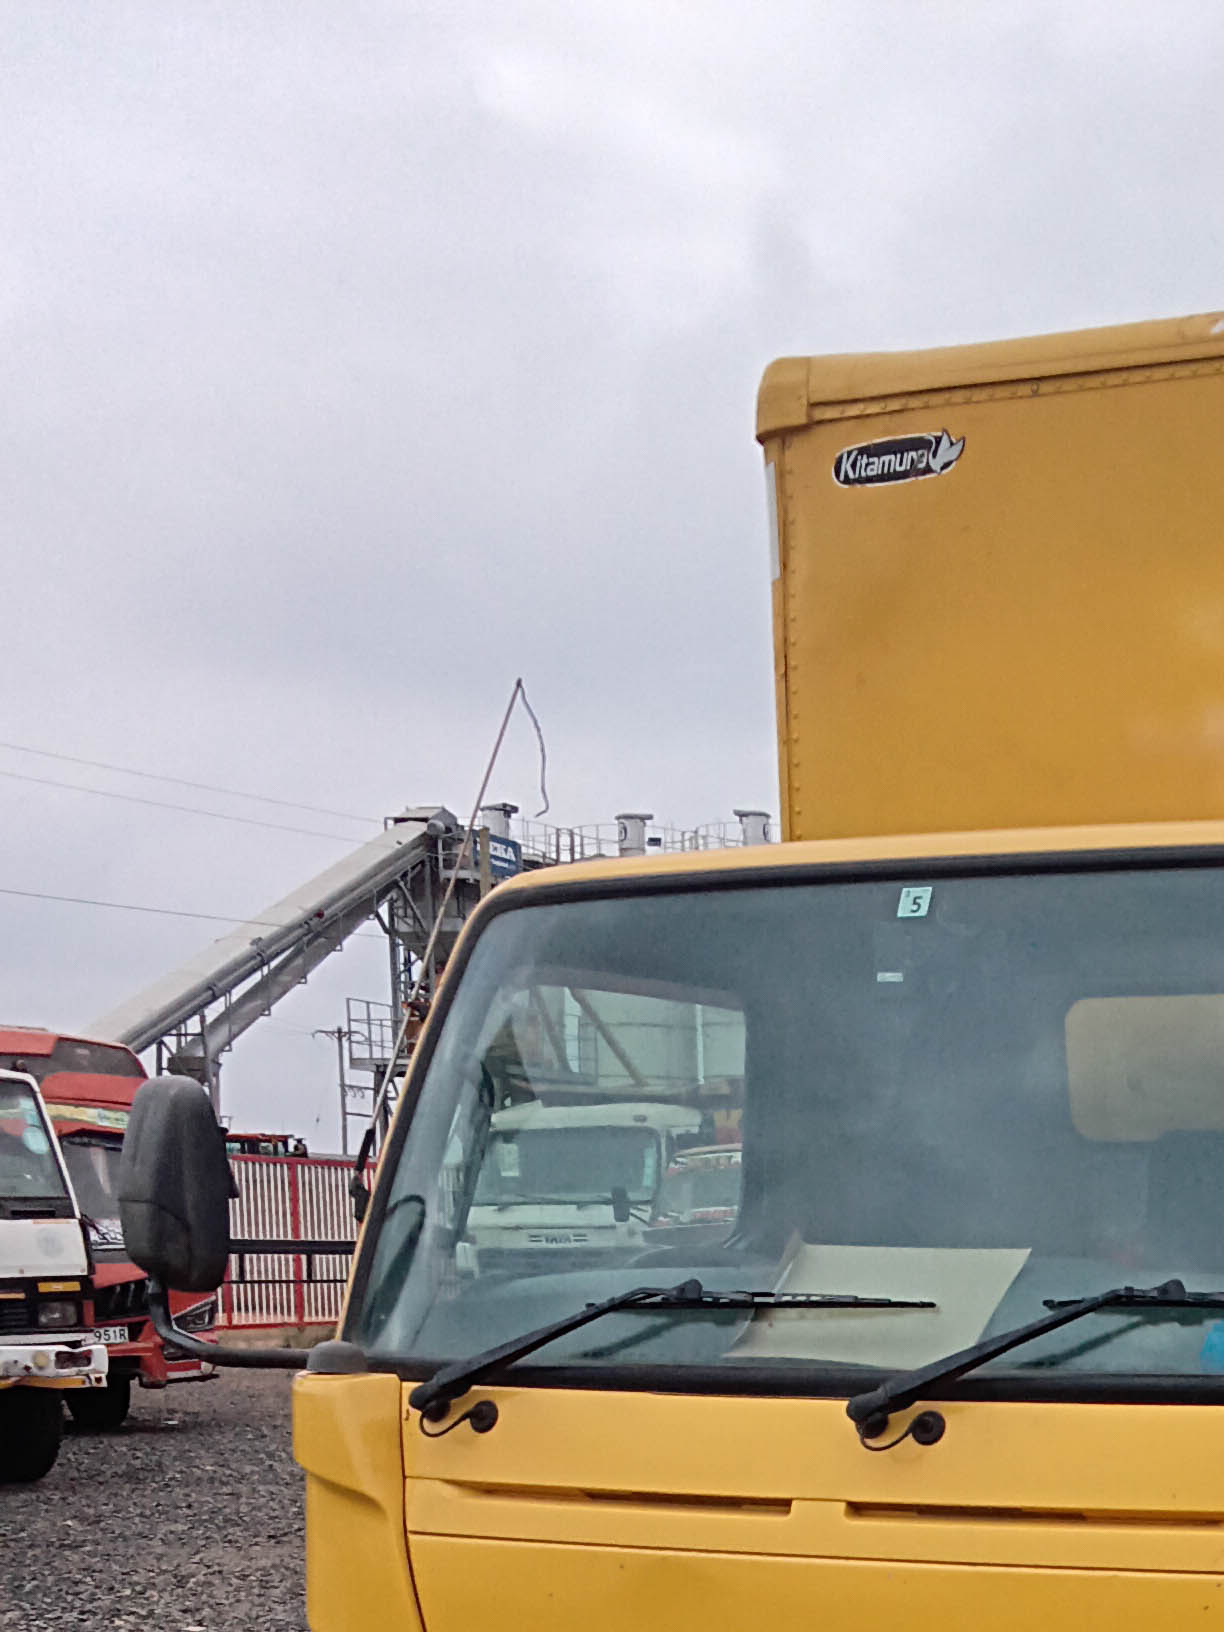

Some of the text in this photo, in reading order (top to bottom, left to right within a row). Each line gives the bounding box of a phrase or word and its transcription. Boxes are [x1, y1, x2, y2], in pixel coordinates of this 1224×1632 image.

[840, 449, 928, 482] Kitamura
[910, 895, 923, 913] 5
[94, 1328, 127, 1342] 951R
